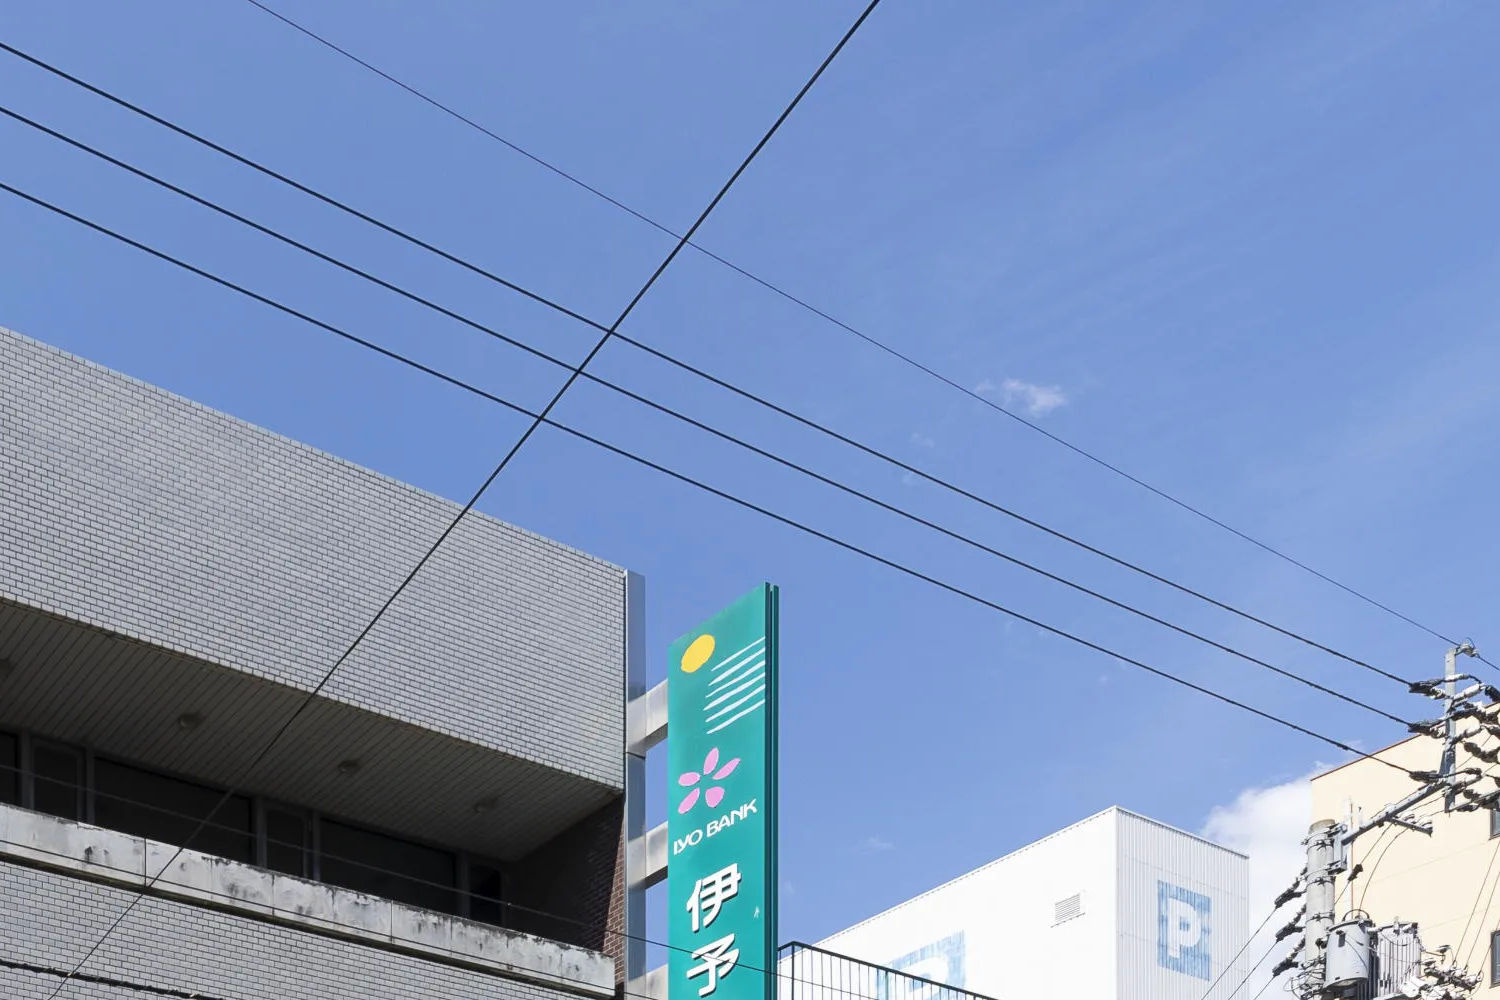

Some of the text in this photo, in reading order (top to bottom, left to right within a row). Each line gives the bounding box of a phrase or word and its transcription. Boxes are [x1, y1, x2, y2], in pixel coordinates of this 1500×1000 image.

[673, 798, 757, 857] IYO BANK
[1167, 896, 1202, 959] P
